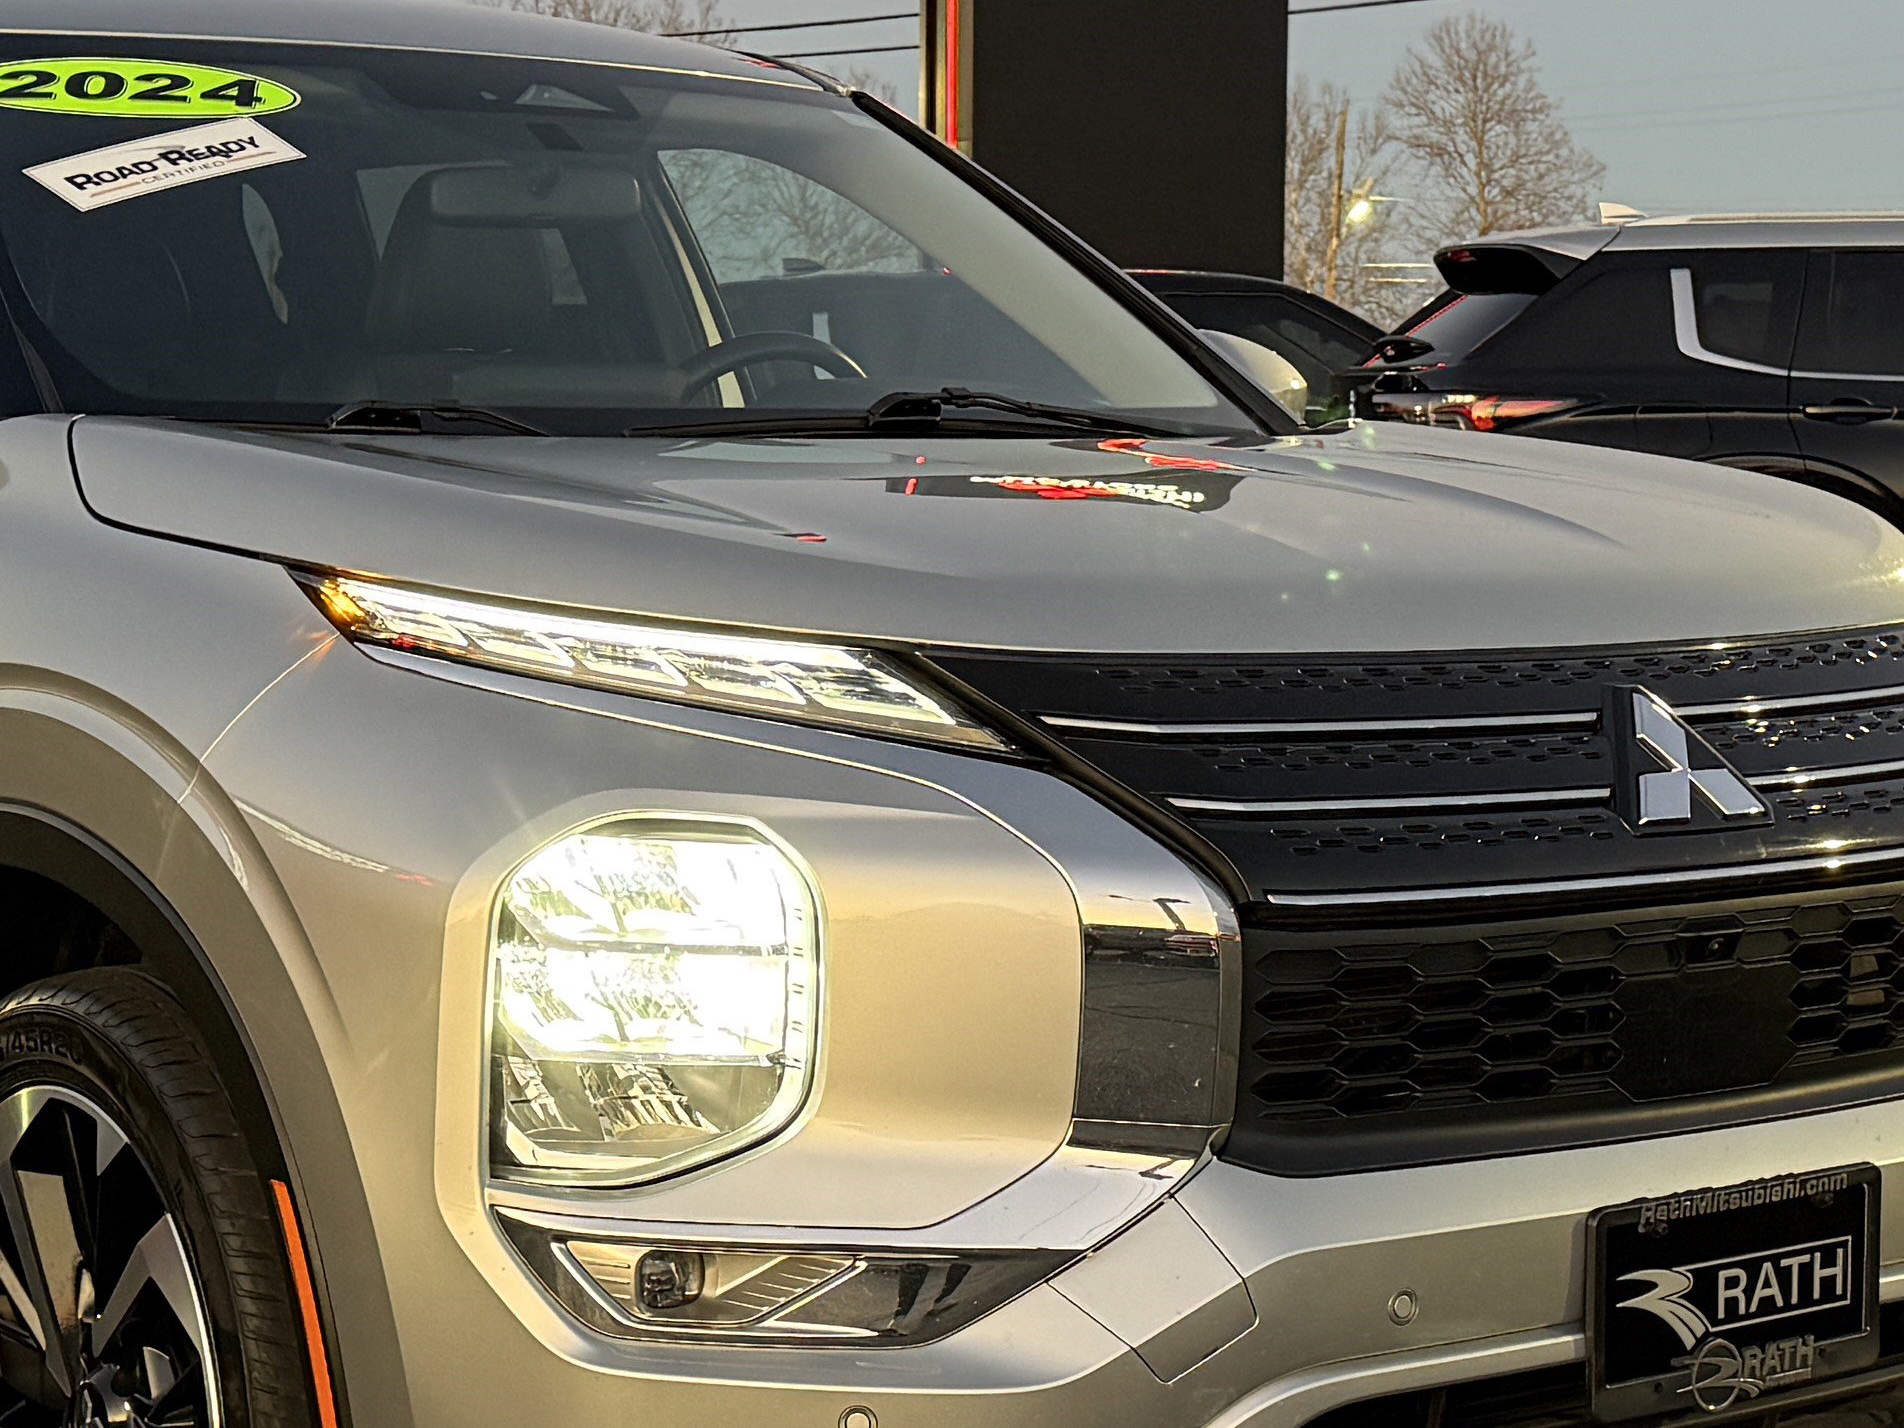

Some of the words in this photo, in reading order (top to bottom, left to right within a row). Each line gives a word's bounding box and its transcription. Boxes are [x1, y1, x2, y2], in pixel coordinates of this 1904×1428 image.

[63, 160, 153, 191] ROAD
[157, 135, 261, 166] READY
[141, 160, 226, 184] CERTIFIED
[1717, 1247, 1845, 1320] RATH
[1741, 1333, 1815, 1379] RATH
